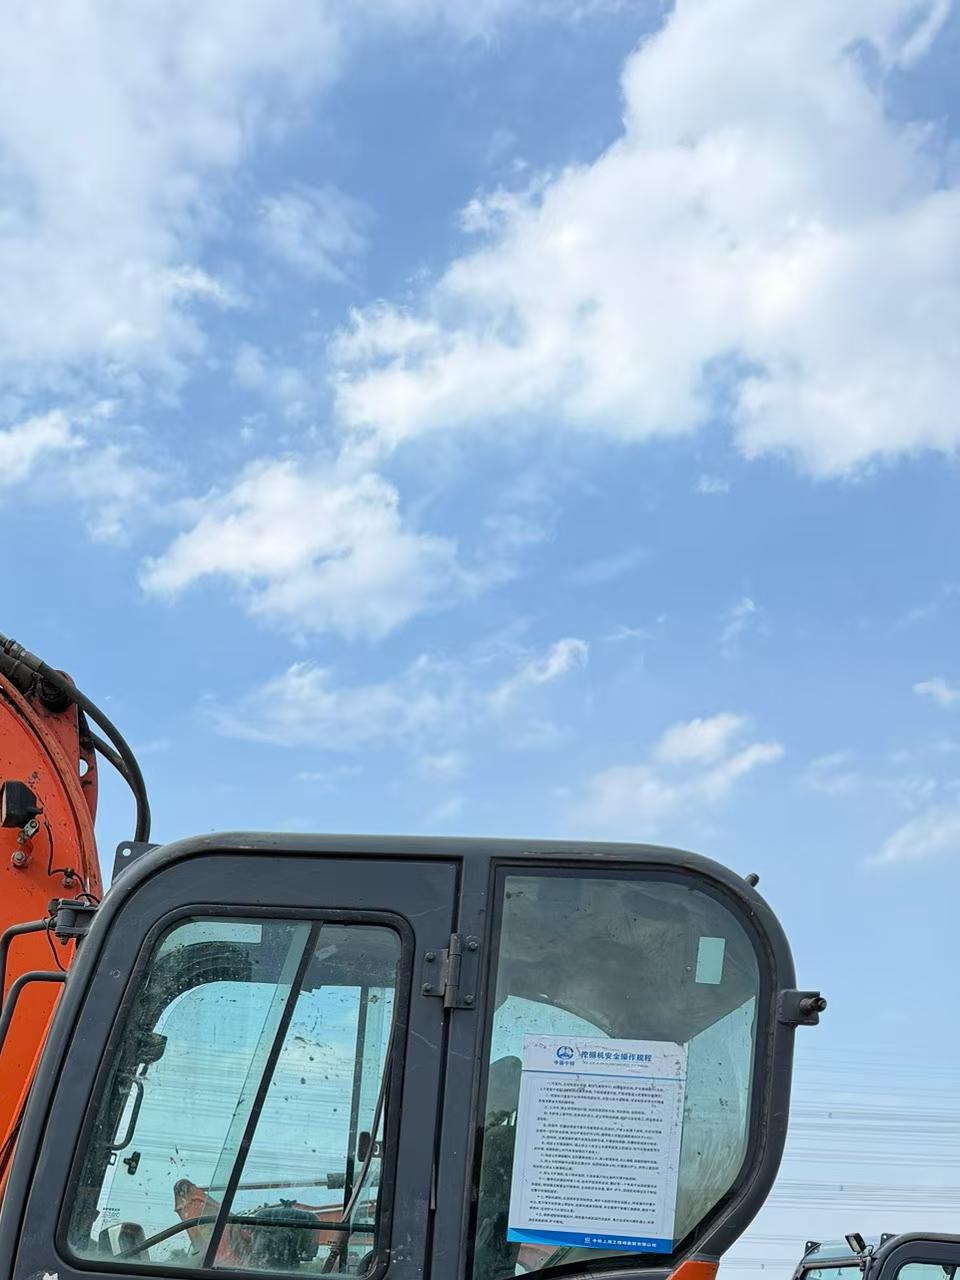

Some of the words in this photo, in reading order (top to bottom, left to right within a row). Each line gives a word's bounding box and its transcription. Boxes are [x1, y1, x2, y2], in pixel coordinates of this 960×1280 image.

[580, 1050, 653, 1062] 挖掘机安全操作规程
